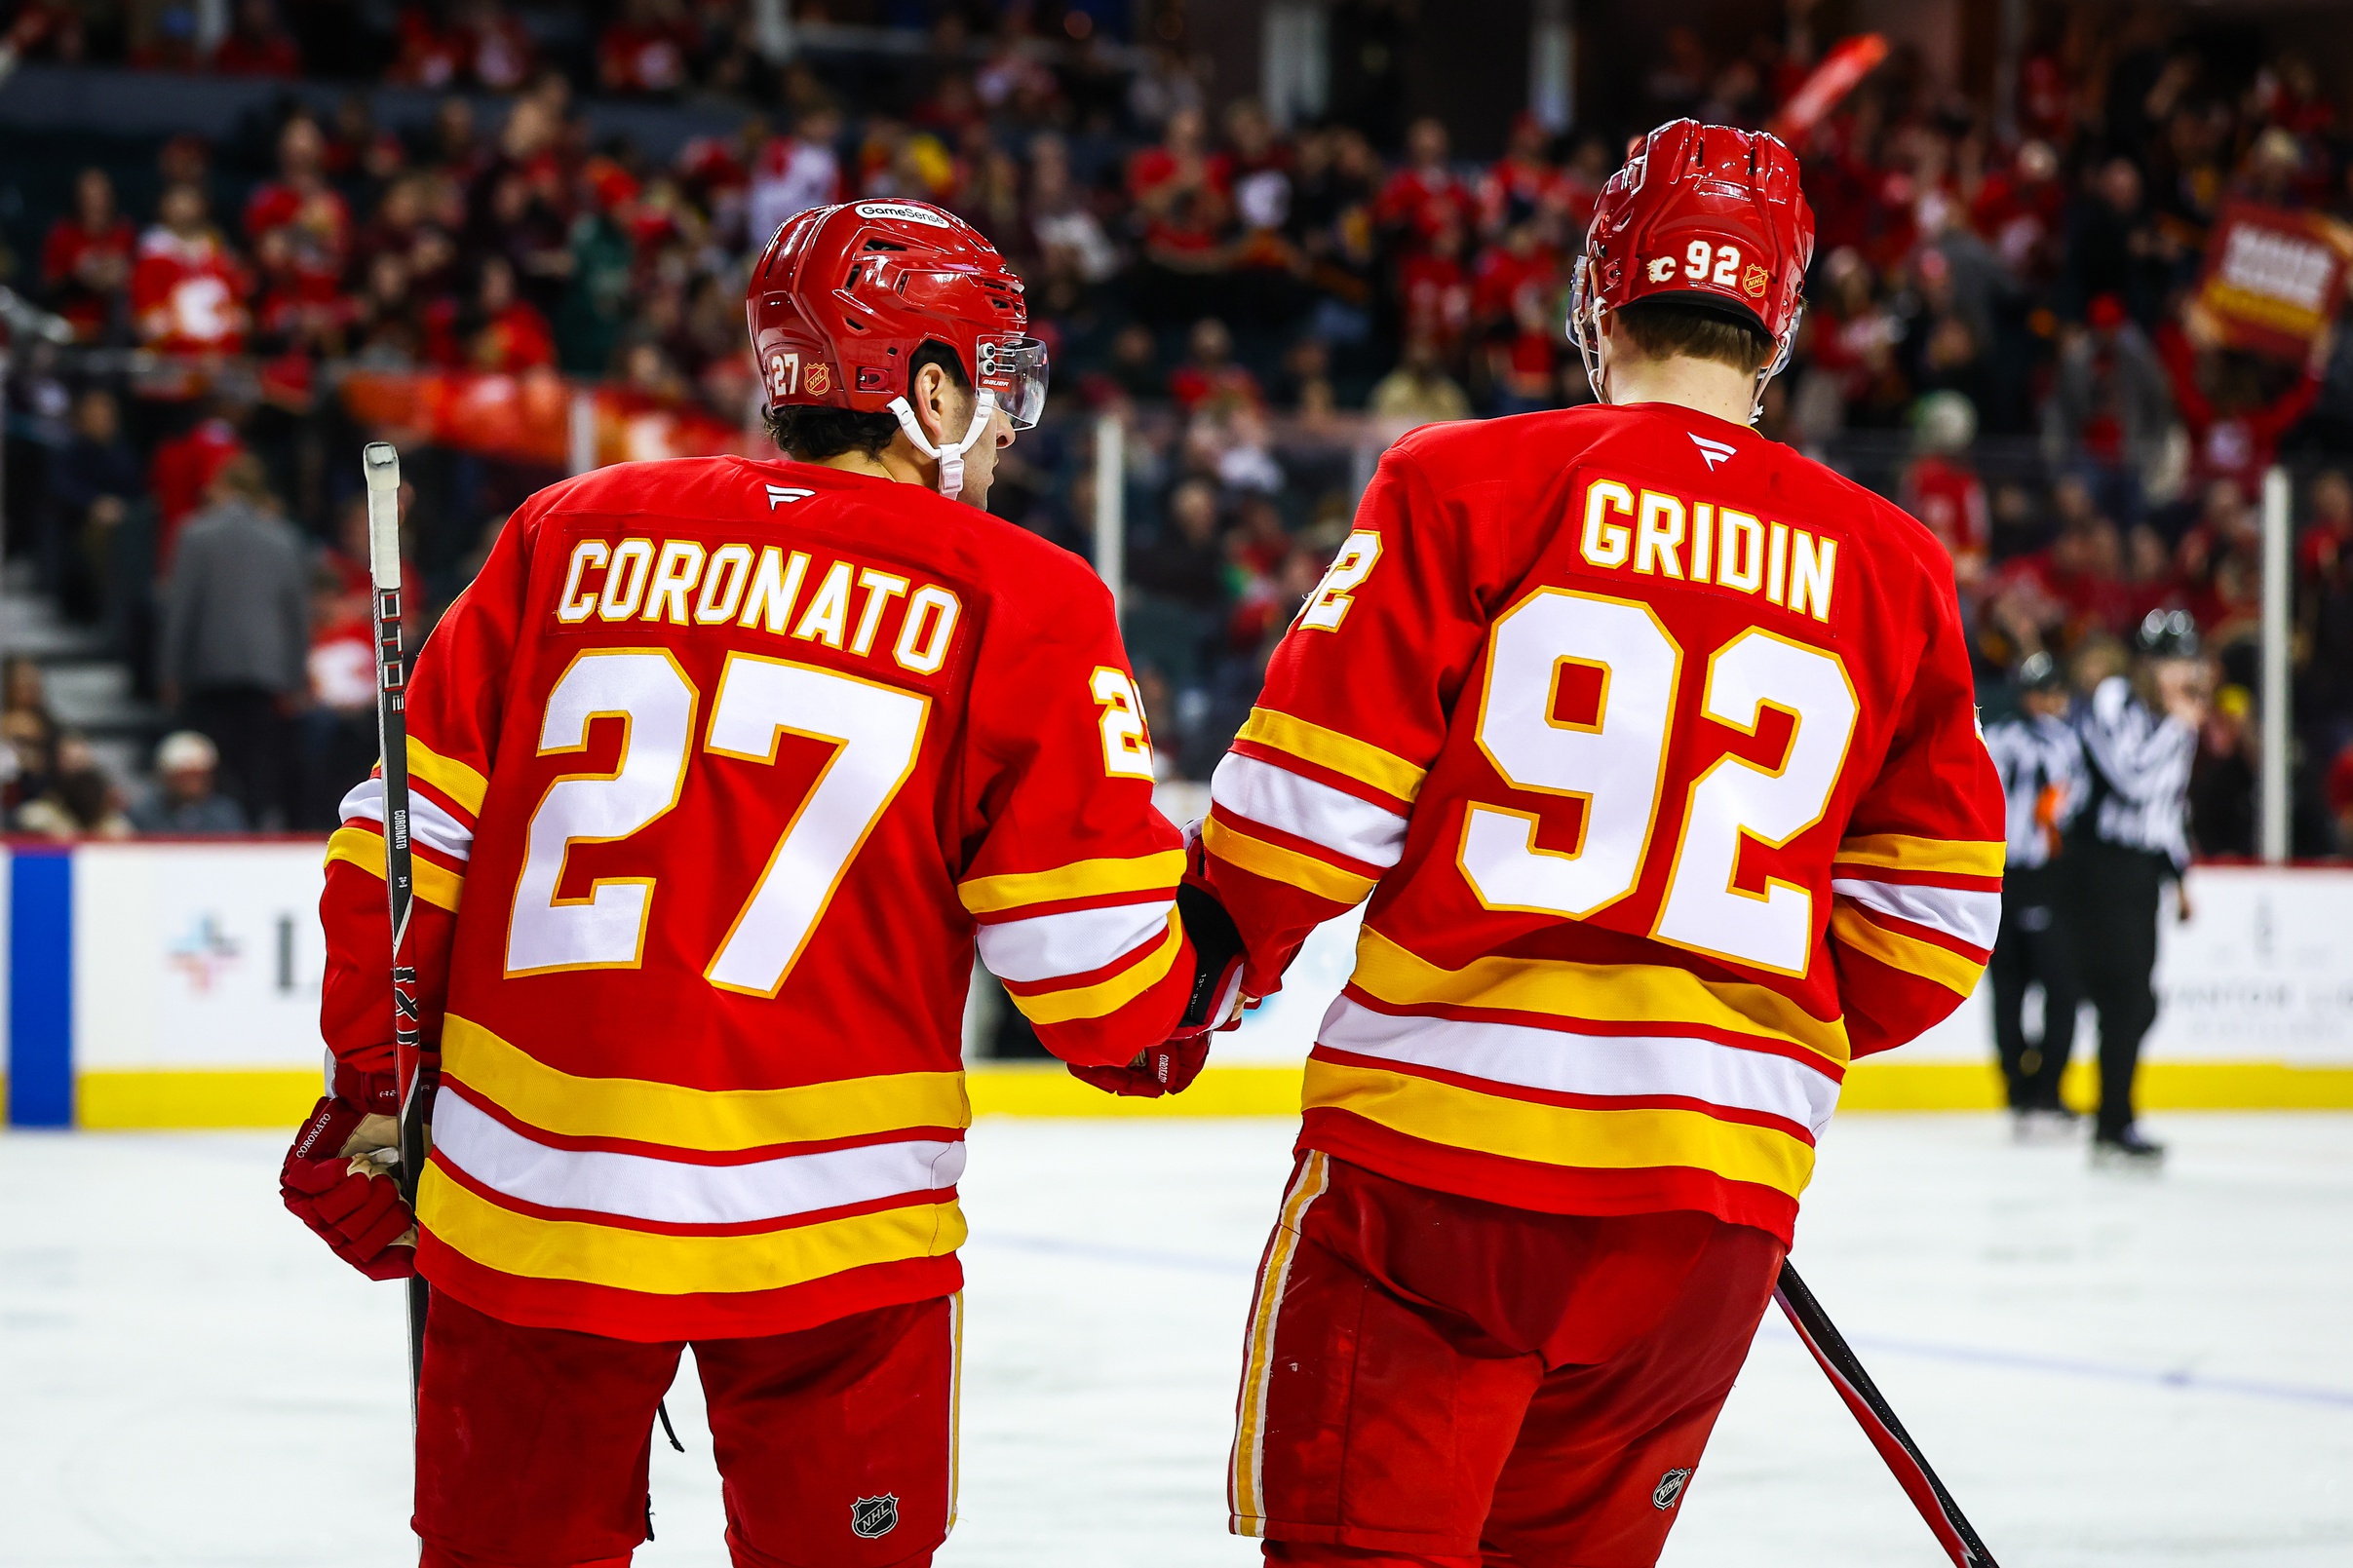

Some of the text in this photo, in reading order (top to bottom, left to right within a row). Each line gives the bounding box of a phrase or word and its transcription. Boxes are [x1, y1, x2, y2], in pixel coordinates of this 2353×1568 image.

[862, 206, 945, 225] GameSense
[1684, 240, 1741, 287] 92
[771, 353, 799, 397] 27
[983, 378, 1010, 387] BAUER
[1579, 478, 1838, 624] GRIDIN
[1287, 528, 1384, 633] 2
[556, 537, 962, 676] CORONATO
[1088, 665, 1155, 784] 2
[1455, 585, 1861, 980] 92
[394, 809, 407, 850] CORONATO
[503, 647, 933, 1000] 27
[295, 1113, 331, 1159] CORONATO
[1658, 1476, 1682, 1501] NHL
[862, 1505, 890, 1531] NHL
